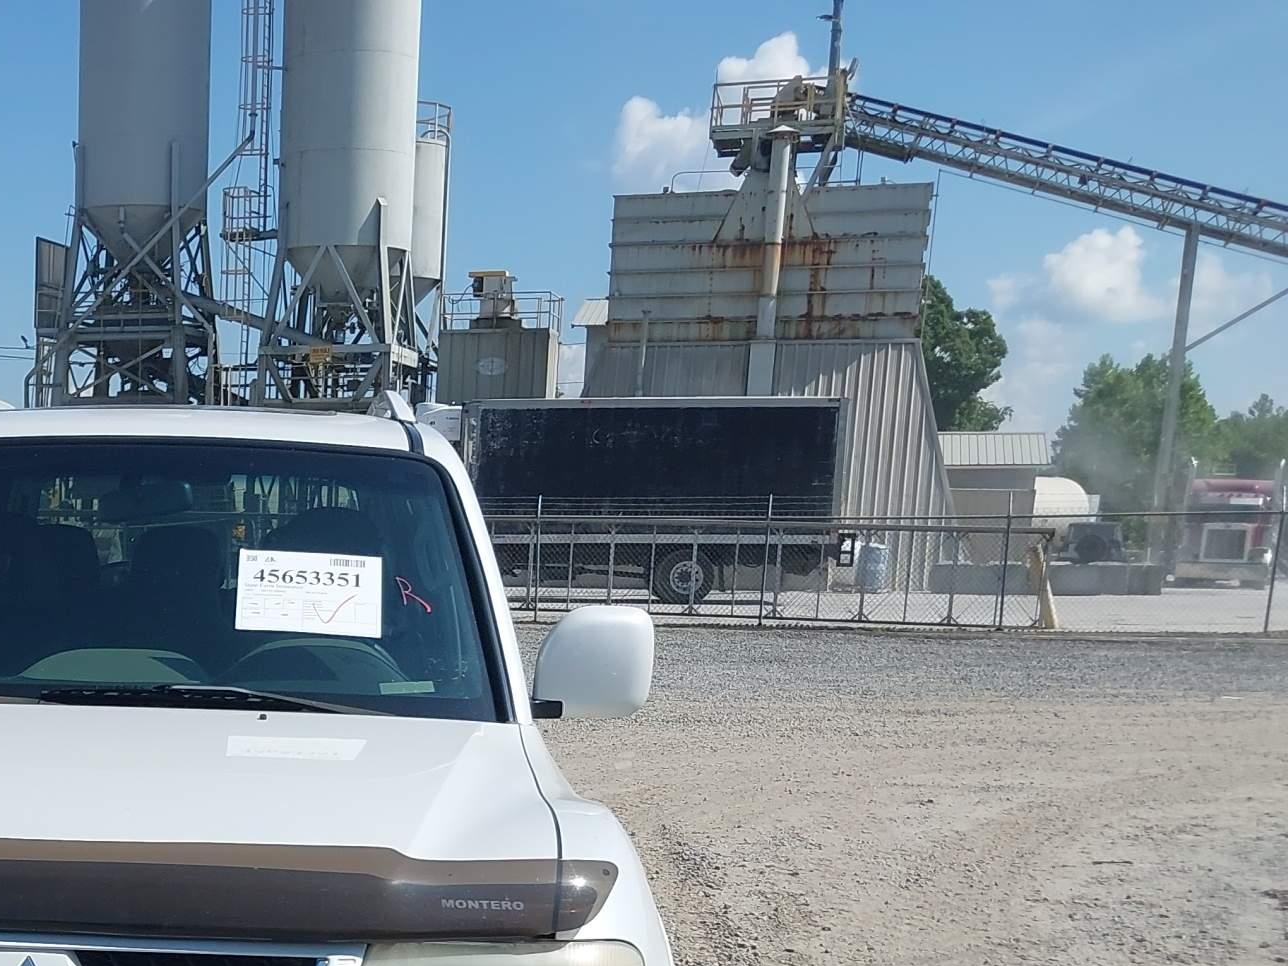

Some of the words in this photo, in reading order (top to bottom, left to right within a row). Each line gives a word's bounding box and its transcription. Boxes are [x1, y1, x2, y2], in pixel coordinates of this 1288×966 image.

[253, 568, 361, 588] 45653351
[396, 576, 432, 614] R
[440, 899, 525, 911] MONTERO
